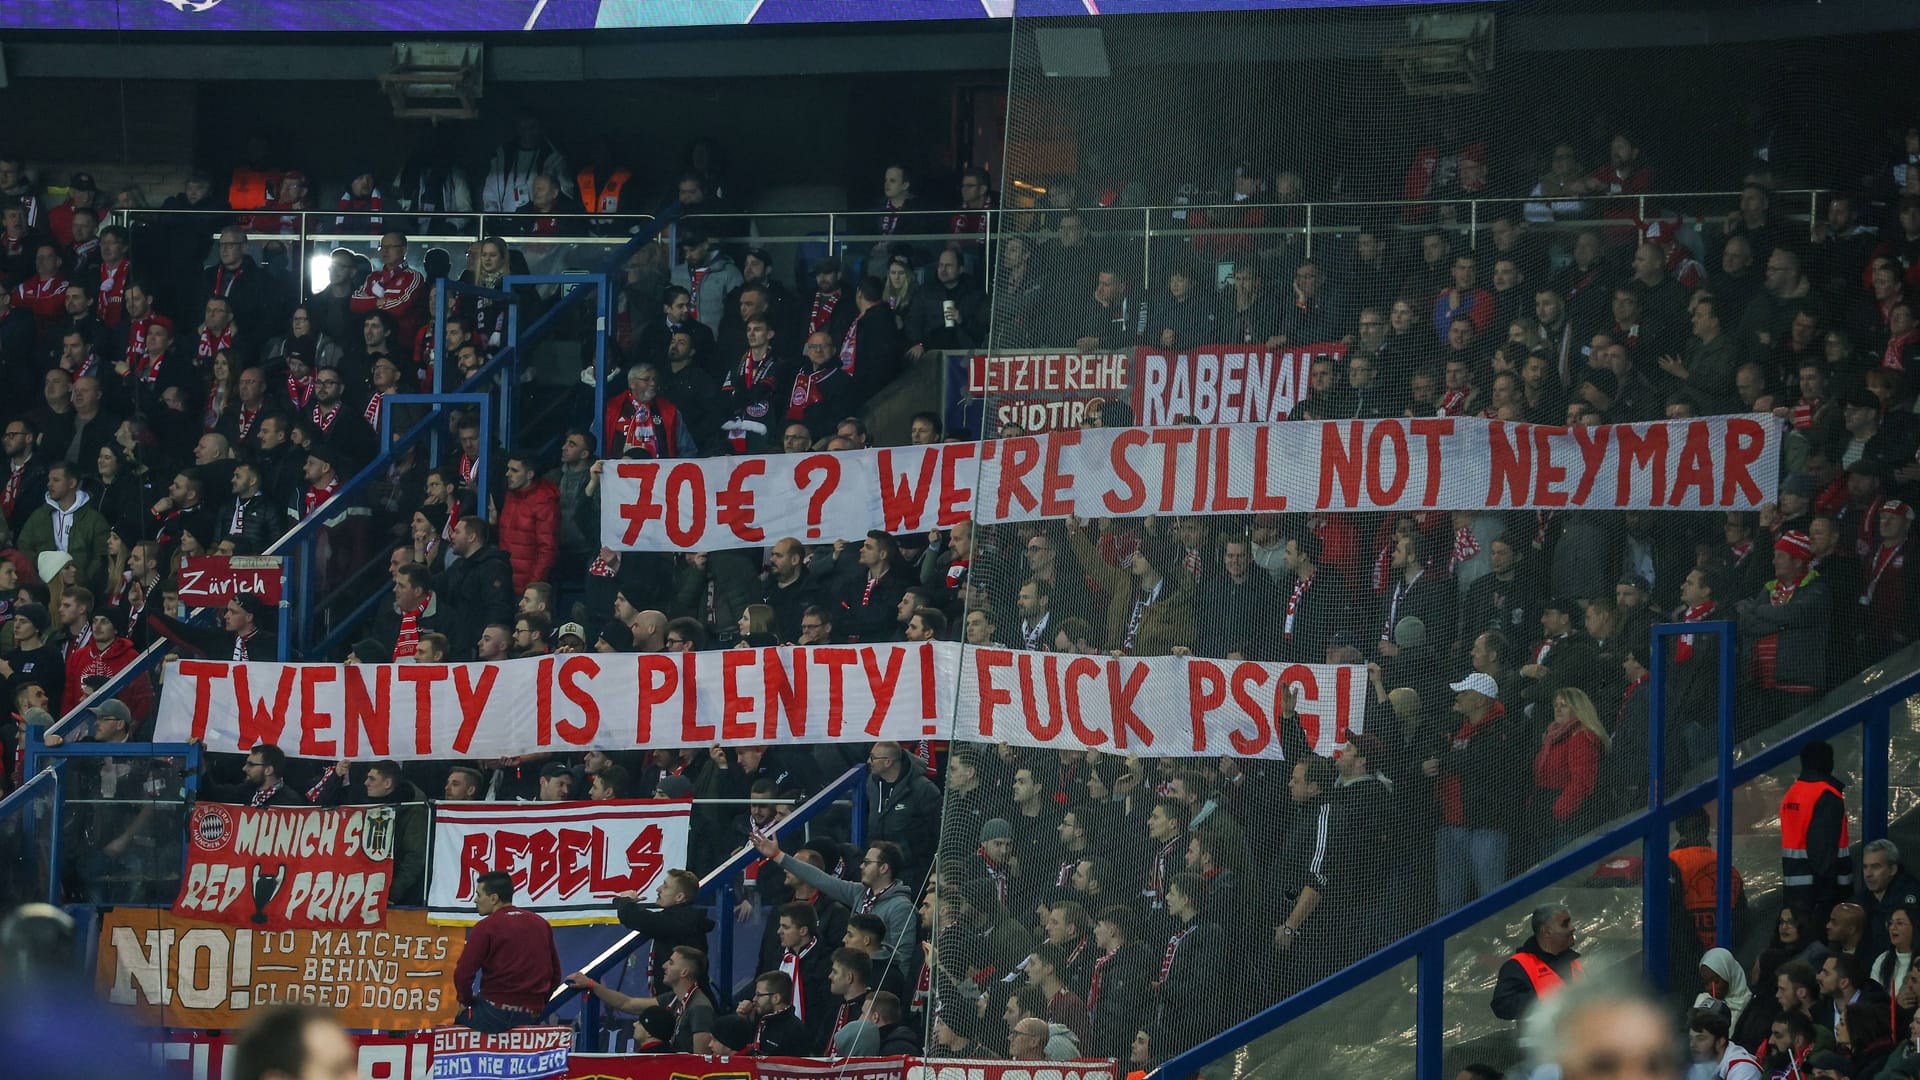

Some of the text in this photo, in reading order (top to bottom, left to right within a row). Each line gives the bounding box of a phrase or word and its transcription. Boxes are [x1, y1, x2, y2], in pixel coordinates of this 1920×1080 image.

[969, 353, 1060, 392] LETZTE
[998, 398, 1118, 432] SÜDTIR
[617, 418, 1765, 548] 70€ ? WE'RE STILL NOT NEYMAR
[178, 570, 266, 595] Zürich
[179, 643, 1351, 760] TWENTY IS PLENTY! FUCK PSG!
[234, 810, 363, 858] MUNICH'S
[456, 824, 664, 902] REBELS
[180, 862, 386, 925] RED PRIDE
[259, 929, 449, 961] TO MATCHES
[109, 926, 253, 1010] NO!
[302, 957, 400, 985] BEHIND
[254, 983, 442, 1012] CLOSED DOORS
[434, 1031, 481, 1052] GUTE
